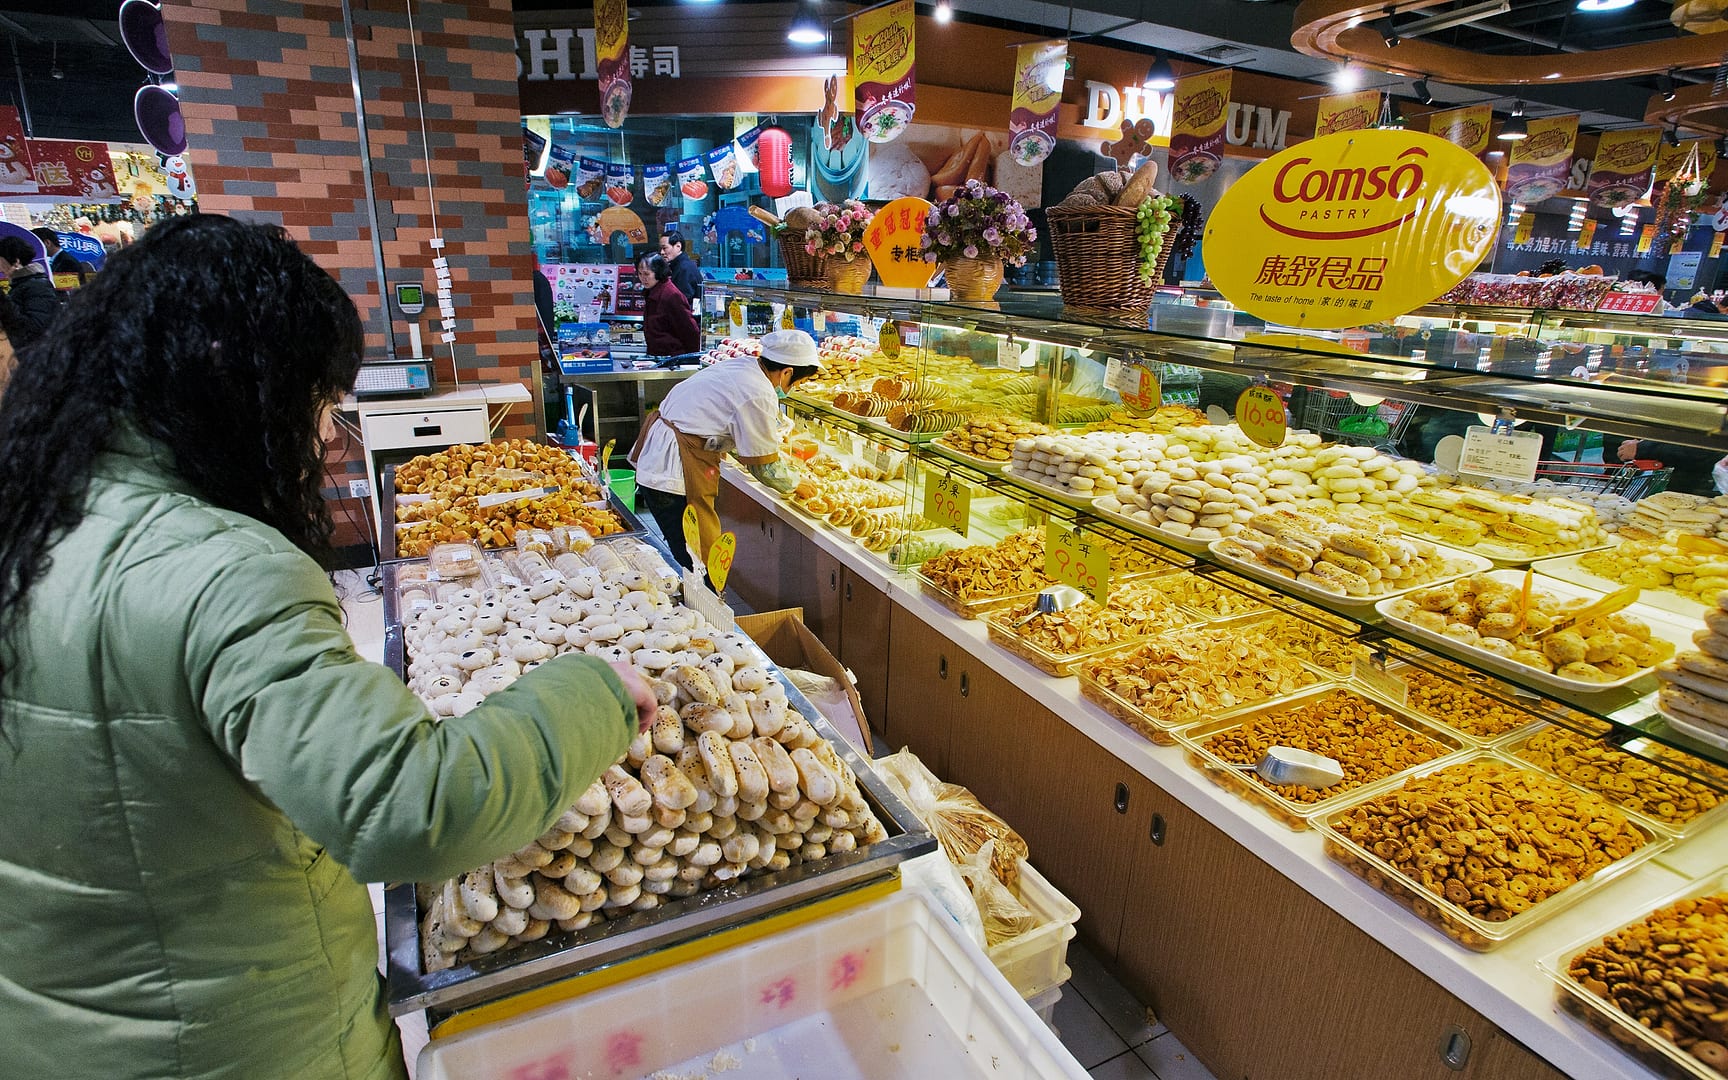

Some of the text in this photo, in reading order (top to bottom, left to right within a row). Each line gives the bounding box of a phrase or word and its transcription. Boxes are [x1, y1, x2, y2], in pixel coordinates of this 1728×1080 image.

[517, 28, 598, 81] HI
[629, 45, 681, 79] 寿司
[1226, 101, 1292, 151] UM
[1273, 147, 1429, 203] Comsô
[1300, 208, 1371, 220] PASTRY
[890, 244, 919, 263] 专柜
[1253, 254, 1389, 291] 康舒食品
[1250, 292, 1263, 302] The
[1265, 293, 1282, 303] taste
[1284, 295, 1293, 304] of
[1294, 295, 1315, 306] home
[1243, 400, 1284, 428] 16.00
[934, 492, 962, 522] 9.90
[1054, 548, 1098, 588] 9.90
